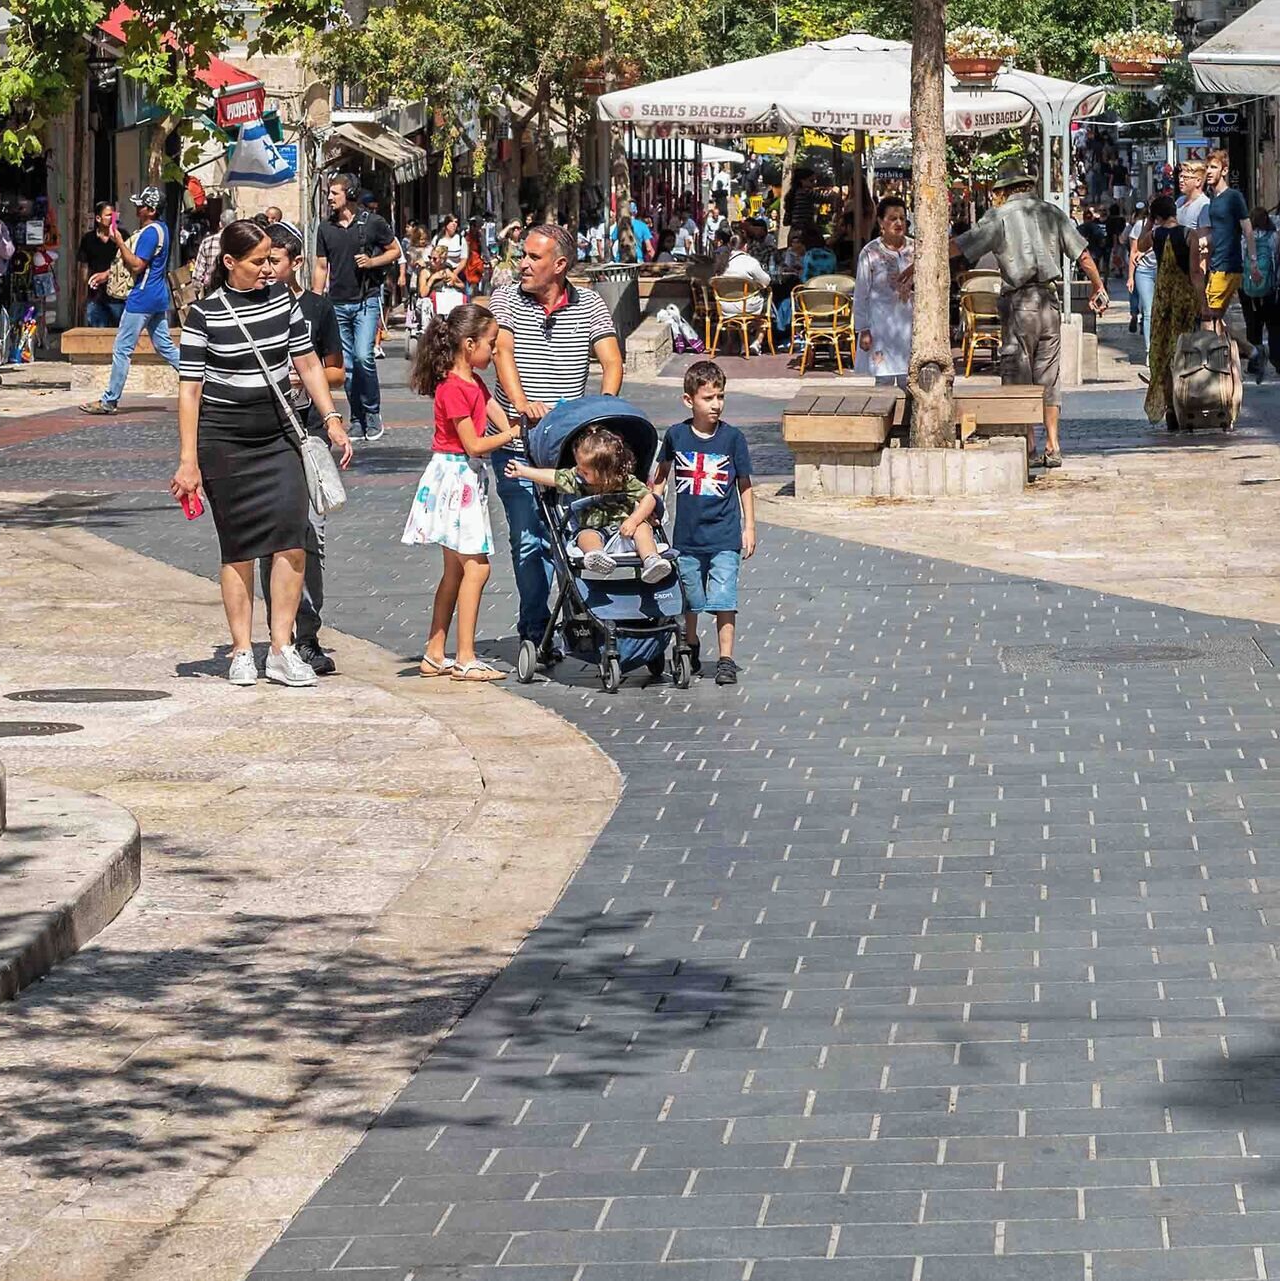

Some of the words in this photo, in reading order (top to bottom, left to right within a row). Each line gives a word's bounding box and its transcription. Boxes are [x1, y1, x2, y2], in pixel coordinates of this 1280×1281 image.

[640, 103, 686, 117] SAM'S
[689, 104, 747, 119] BAGELS
[974, 113, 994, 127] SAM'S
[995, 110, 1024, 125] BAGELS
[862, 113, 893, 127] סאם
[678, 123, 722, 136] SAM'S
[724, 122, 780, 135] BAGELS
